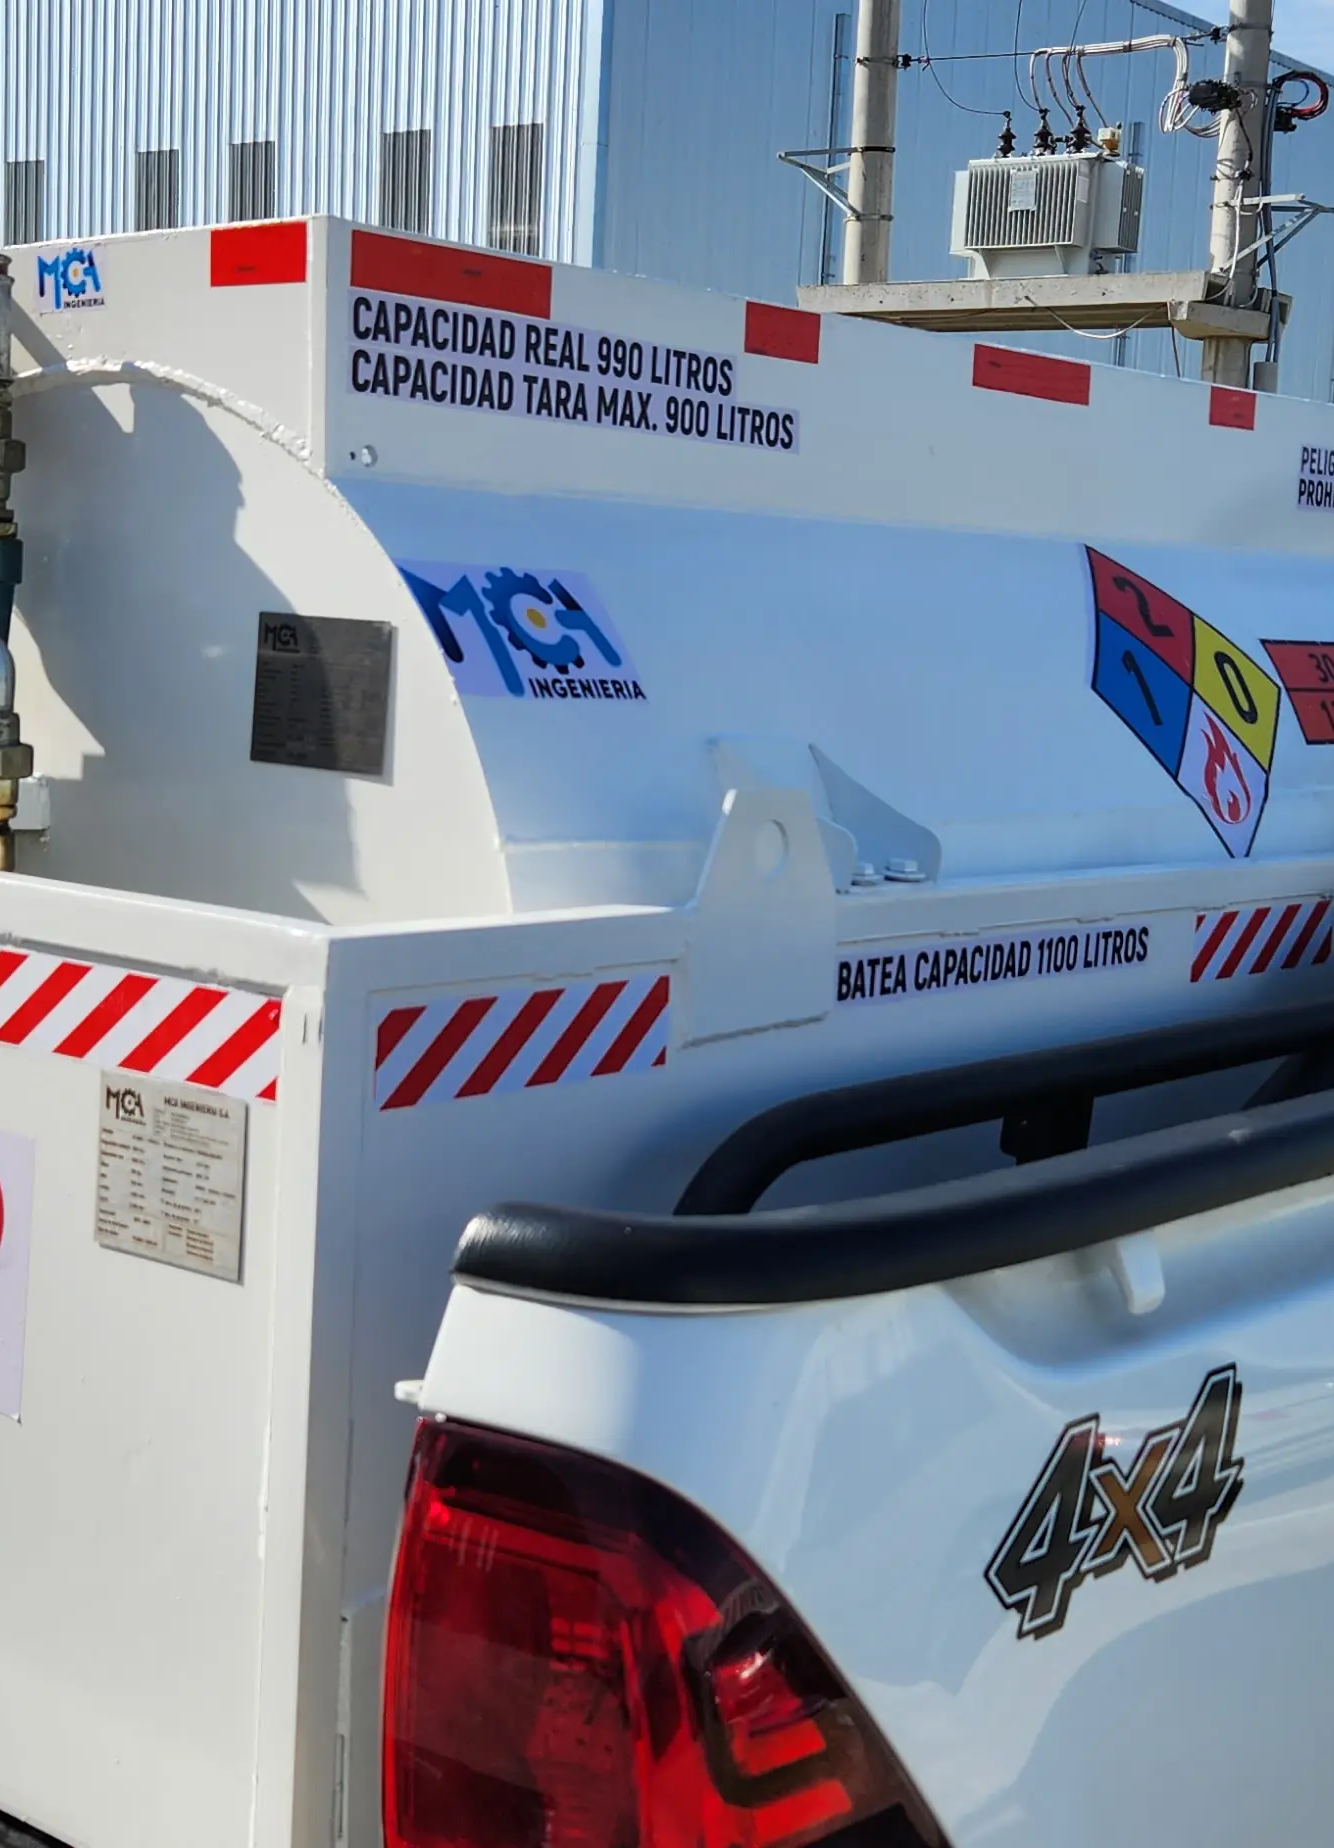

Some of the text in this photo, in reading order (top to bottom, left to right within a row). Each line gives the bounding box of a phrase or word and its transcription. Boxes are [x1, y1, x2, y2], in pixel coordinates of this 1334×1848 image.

[37, 247, 101, 309] MCA
[64, 297, 105, 308] INGENIERIA
[352, 297, 733, 396] CAPACIDAD REAL 990 LITROS
[351, 349, 794, 450] CAPACIDAD TARA MAX. 900 LITROS
[397, 565, 622, 698] MCA
[1113, 576, 1175, 638] 2
[528, 677, 647, 700] INGENIERIA
[1122, 650, 1163, 726] 1
[1214, 650, 1258, 724] 0
[837, 927, 1149, 1001] BATEA CAPACIDAD 1100 LITROS
[106, 1085, 144, 1120] MCA
[983, 1362, 1244, 1640] 4x4
